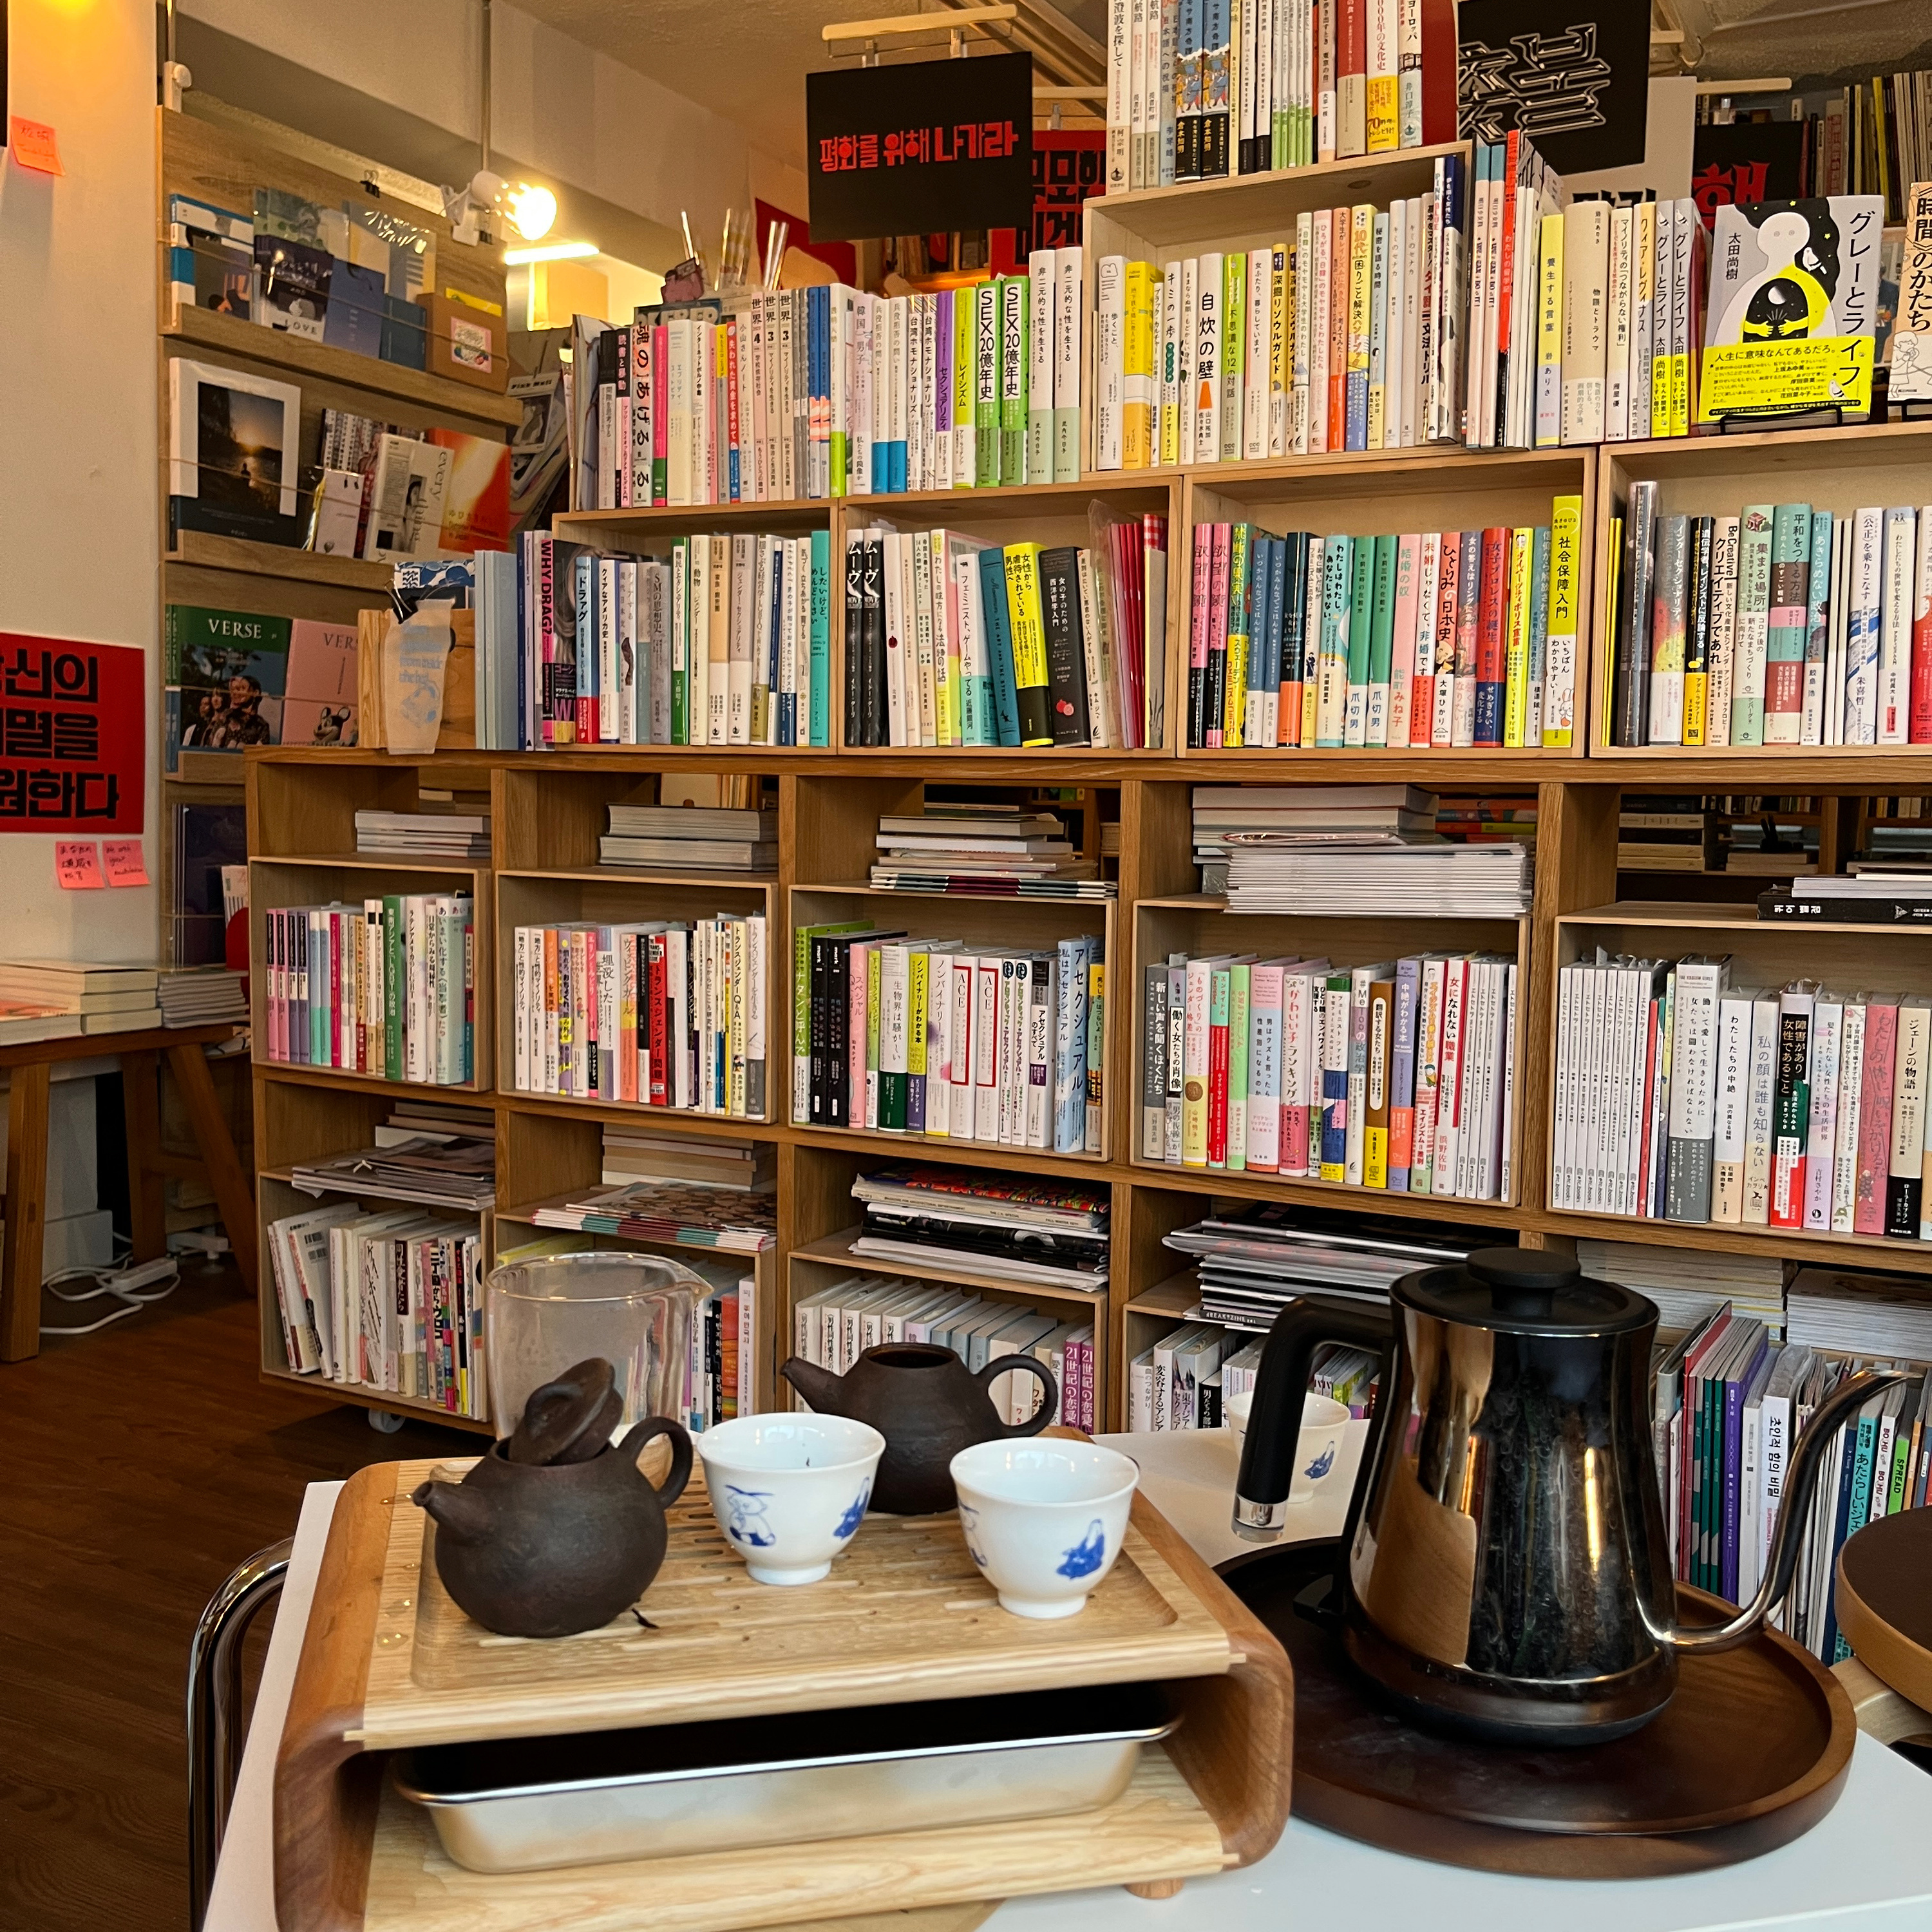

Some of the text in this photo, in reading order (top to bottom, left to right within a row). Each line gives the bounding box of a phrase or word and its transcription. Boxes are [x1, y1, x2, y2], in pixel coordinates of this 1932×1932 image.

[883, 127, 929, 166] 위해
[1616, 219, 1629, 347] マイノリティの「つながらない権利」
[1655, 234, 1669, 330] グレーとライフ
[1674, 232, 1688, 328] グレーとライフ
[1725, 232, 1742, 281] 太田尚樹
[782, 330, 789, 341] 3
[1037, 267, 1047, 363] 非二元的な性を生きる
[1064, 264, 1073, 362] 非二元的な性を生きる
[1166, 272, 1175, 338] キミの一歩
[1198, 292, 1216, 380] 自炊の壁
[1254, 262, 1262, 359] 女ふたり、暮らしています。
[1273, 275, 1283, 375] 深掘りソウルガイド
[1592, 289, 1600, 352] 物語とトラウマ
[1839, 211, 1875, 390] グレーとライフ
[753, 333, 761, 344] 4
[768, 331, 774, 342] 3
[1656, 337, 1666, 379] 太田尚樹
[1674, 336, 1684, 378] 太田尚樹
[958, 364, 967, 407] レイシズム
[542, 540, 553, 636] WHY DRAG?
[848, 540, 862, 585] ムーヴ
[864, 540, 879, 585] ムーヴ
[1023, 553, 1032, 591] 女性から
[1231, 526, 1246, 596] 禁断の果実
[1324, 554, 1334, 621] あなたじゃない。
[1334, 544, 1344, 613] わたしはわたし。
[1398, 548, 1411, 597] 結婚の奴
[1439, 544, 1457, 641] ひとりみの日本史
[1486, 541, 1502, 643] 女子プロレスの誕生
[1555, 536, 1572, 620] 社会保障入門
[1727, 538, 1737, 576] Creative
[1788, 513, 1806, 603] 平和をつくる方法
[1810, 535, 1826, 624] あきらめない政治
[1891, 534, 1904, 629] わたしたちの世界を変える方法
[208, 618, 262, 639] VERSE
[578, 576, 589, 623] ドラァグ
[653, 573, 663, 634] SMの思想史
[819, 566, 828, 620] したいけど、
[1058, 577, 1068, 633] 女の子のための
[1253, 553, 1264, 634] いつかみんなでごはんを
[1271, 554, 1282, 635] いつかみんなでごはんを
[1709, 538, 1726, 665] クリエイティブであれ
[961, 575, 972, 697] フェミニスト、ゲームやってる
[1561, 639, 1570, 674] いちばん
[1745, 618, 1757, 680] 新たなまちづくり
[1756, 618, 1765, 653] コロナ後の
[0, 647, 99, 703] 신의
[1349, 691, 1360, 729] 爪切男
[1371, 690, 1382, 727] 爪切男
[1437, 679, 1448, 726] 大塚ひかり
[1855, 676, 1866, 706] 朱喜哲
[0, 708, 99, 761] 멸을
[653, 965, 663, 1080] トランスジェンダー問題
[795, 973, 806, 1057] ナタンと呼んで
[892, 980, 902, 1061] 生物界は騒がしい
[915, 960, 923, 1043] ノンバイナリーがわかる本
[935, 960, 946, 1031] ノンバイナリー
[958, 972, 966, 1009] ACE
[984, 974, 993, 1010] ACE
[1059, 949, 1070, 1042] 私はアセクシュアル
[1071, 948, 1084, 1092] アセクシュアル
[1399, 983, 1410, 1043] 中絶がわかる本
[1444, 976, 1459, 1062] 女になれない職業
[1037, 1009, 1046, 1061] アセクシュアル
[1154, 981, 1166, 1095] 新しい声を聞くぼくたち
[1170, 1010, 1183, 1090] 働く女たちの肖像
[1255, 1017, 1264, 1096] 性差別になるのか
[1264, 1018, 1273, 1098] 男はクズと言ったら
[1286, 989, 1299, 1099] かわいい子ランキング
[1354, 980, 1367, 1074] #MeTooの政治学
[1374, 1003, 1384, 1054] 翻訳する女たち
[1726, 1016, 1739, 1094] わたしたちの中絶
[1780, 1019, 1795, 1094] 女性であること
[1794, 1019, 1807, 1075] 障害があり
[1904, 1019, 1920, 1090] ジェーンの物語
[1752, 1035, 1773, 1169] 私の顔は誰も知らない
[1065, 1346, 1079, 1423] 21世紀の恋愛
[1081, 1348, 1094, 1425] 21世紀の恋愛
[1766, 1416, 1782, 1498] 초인적 힘의 비밀
[1893, 1457, 1905, 1494] SPREAD
